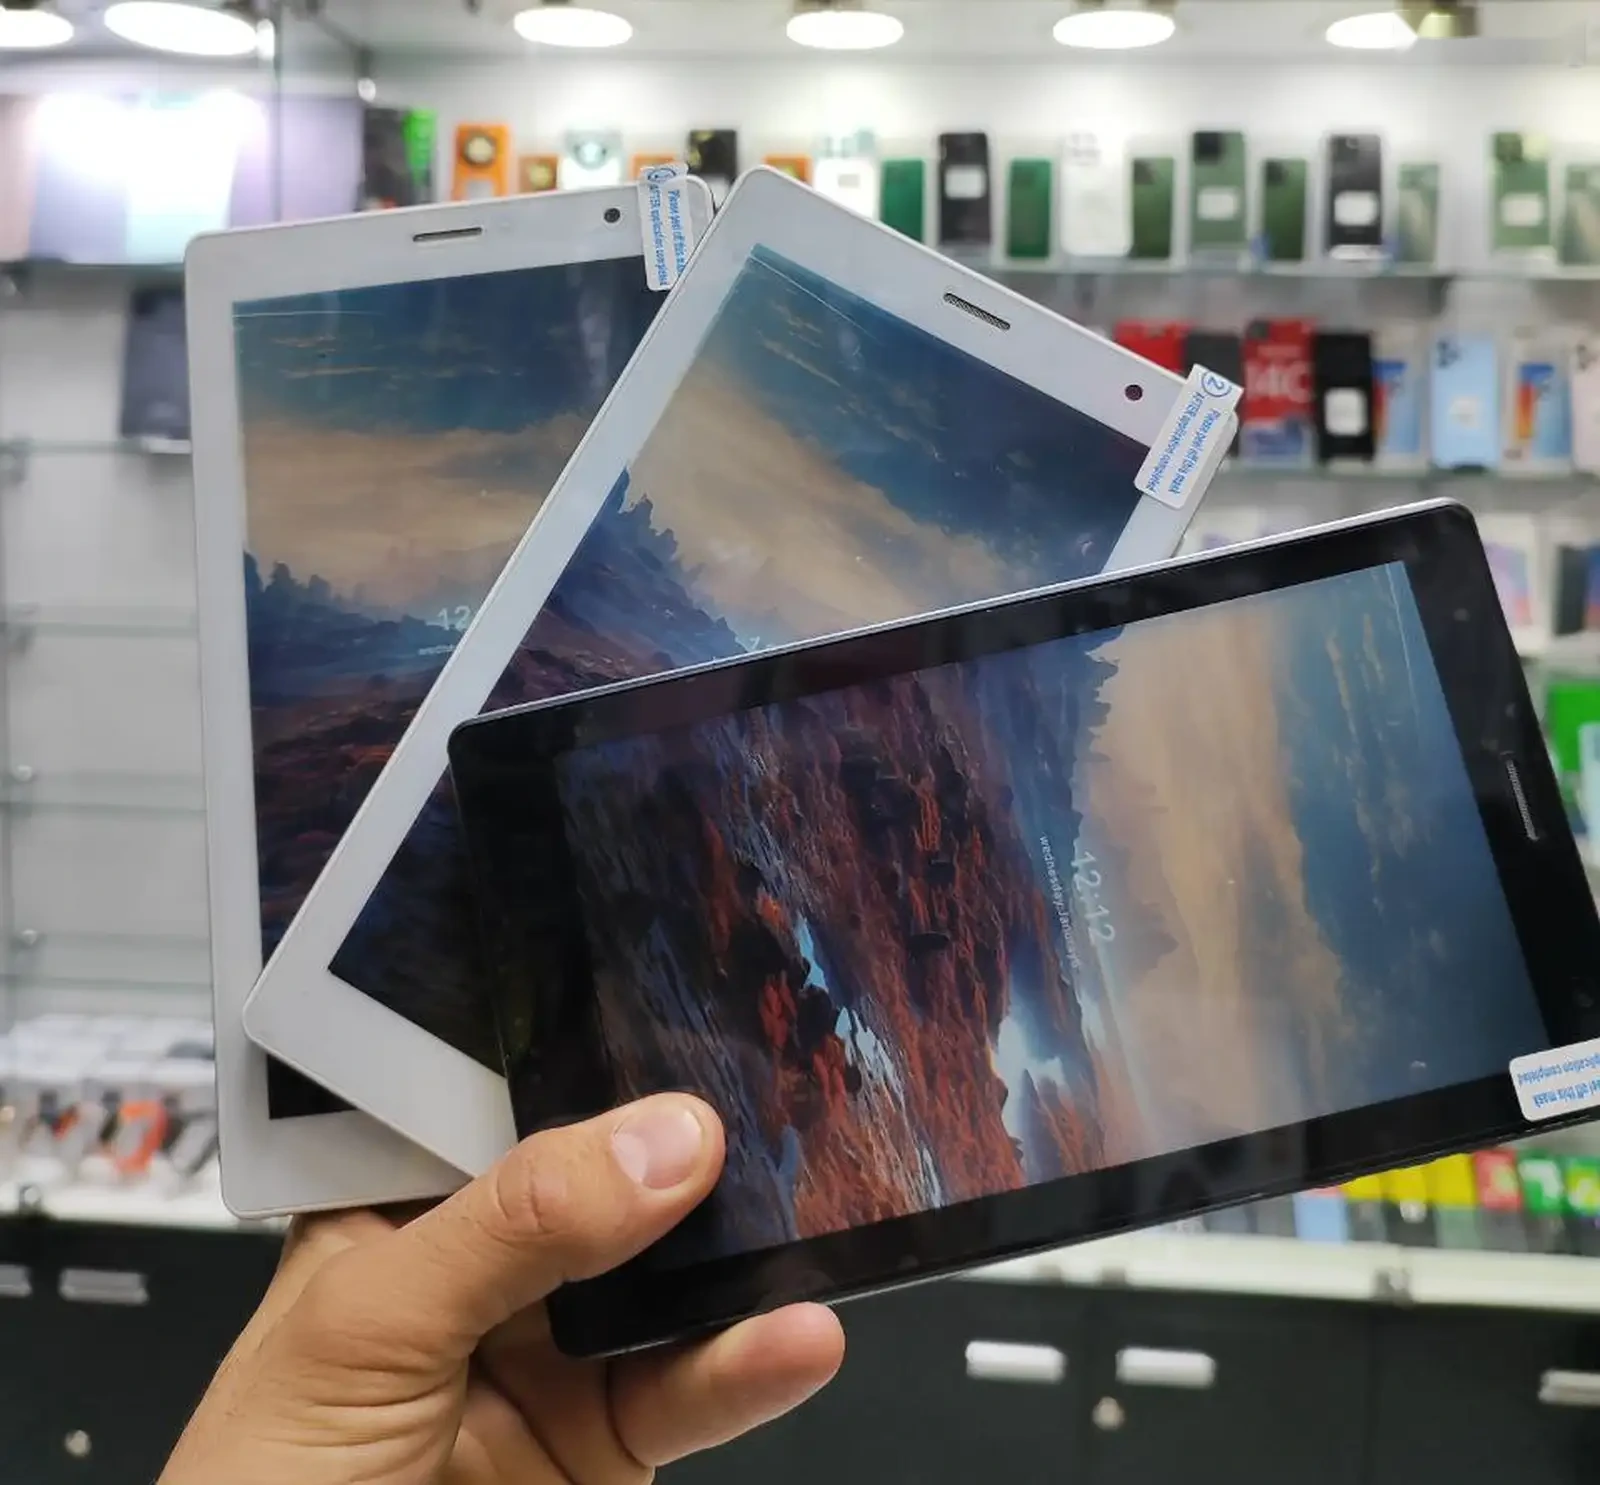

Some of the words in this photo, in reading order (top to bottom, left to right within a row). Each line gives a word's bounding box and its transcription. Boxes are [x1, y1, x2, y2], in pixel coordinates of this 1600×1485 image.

[1186, 391, 1206, 417] AFTER
[1200, 408, 1220, 433] Please
[1166, 414, 1192, 455] application
[1191, 430, 1206, 450] peel
[1178, 458, 1194, 475] this
[1186, 447, 1199, 462] off
[1146, 453, 1171, 492] completed
[1168, 473, 1185, 494] mask
[1070, 851, 1116, 946] 12:12
